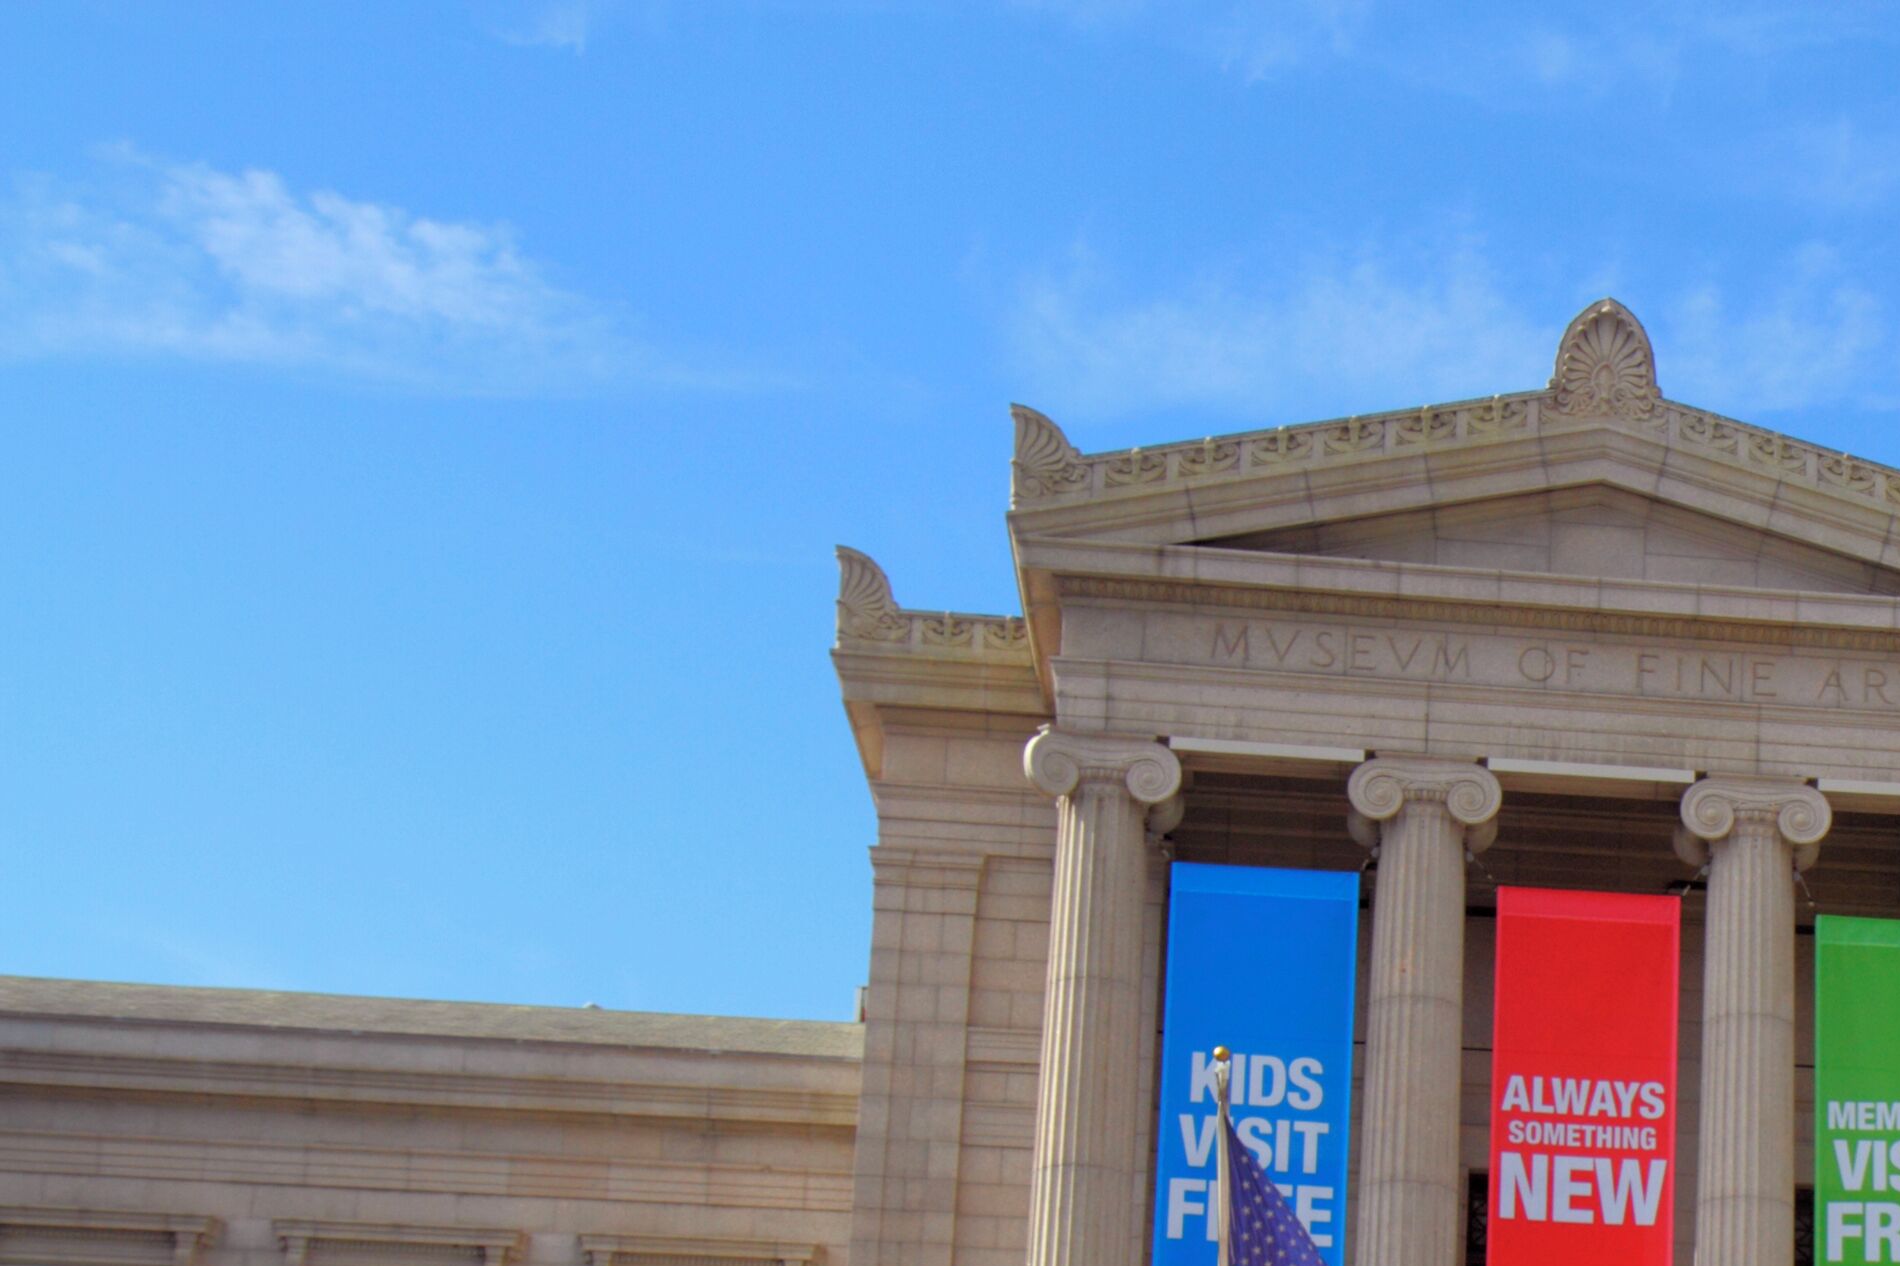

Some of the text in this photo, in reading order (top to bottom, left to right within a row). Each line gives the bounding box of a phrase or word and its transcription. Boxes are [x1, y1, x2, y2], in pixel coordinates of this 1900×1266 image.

[1209, 622, 1471, 678] MVSEVM
[1517, 645, 1590, 682] OF
[1634, 653, 1777, 697] FINE
[1189, 1051, 1324, 1110] KIDS
[1501, 1074, 1665, 1120] ALWAYS
[1179, 1113, 1330, 1174] VSIT
[1508, 1119, 1657, 1150] SOMETHING
[1166, 1177, 1334, 1247] FE
[1499, 1151, 1668, 1227] NEW
